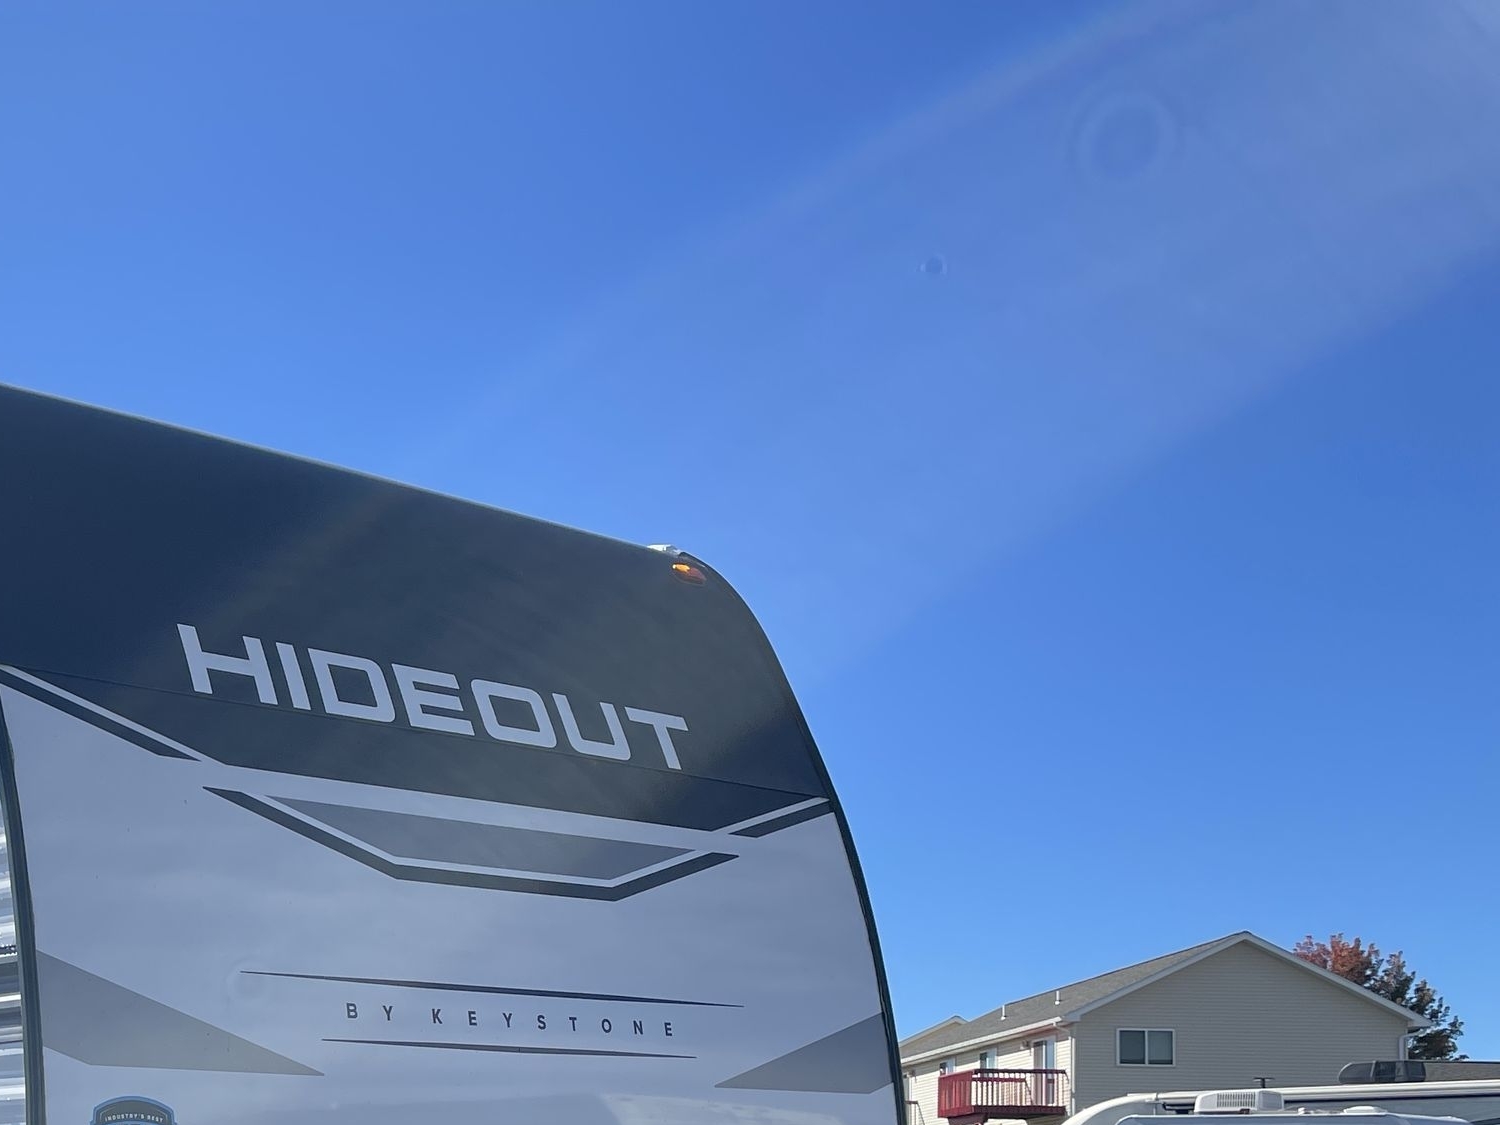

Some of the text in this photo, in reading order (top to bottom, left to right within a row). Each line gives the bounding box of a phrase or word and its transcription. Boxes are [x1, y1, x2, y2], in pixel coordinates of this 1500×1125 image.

[176, 623, 689, 771] HIDEOUT
[346, 1002, 674, 1037] BY KEYSTONE
[104, 1113, 164, 1123] INDUSTRY'S BEST
